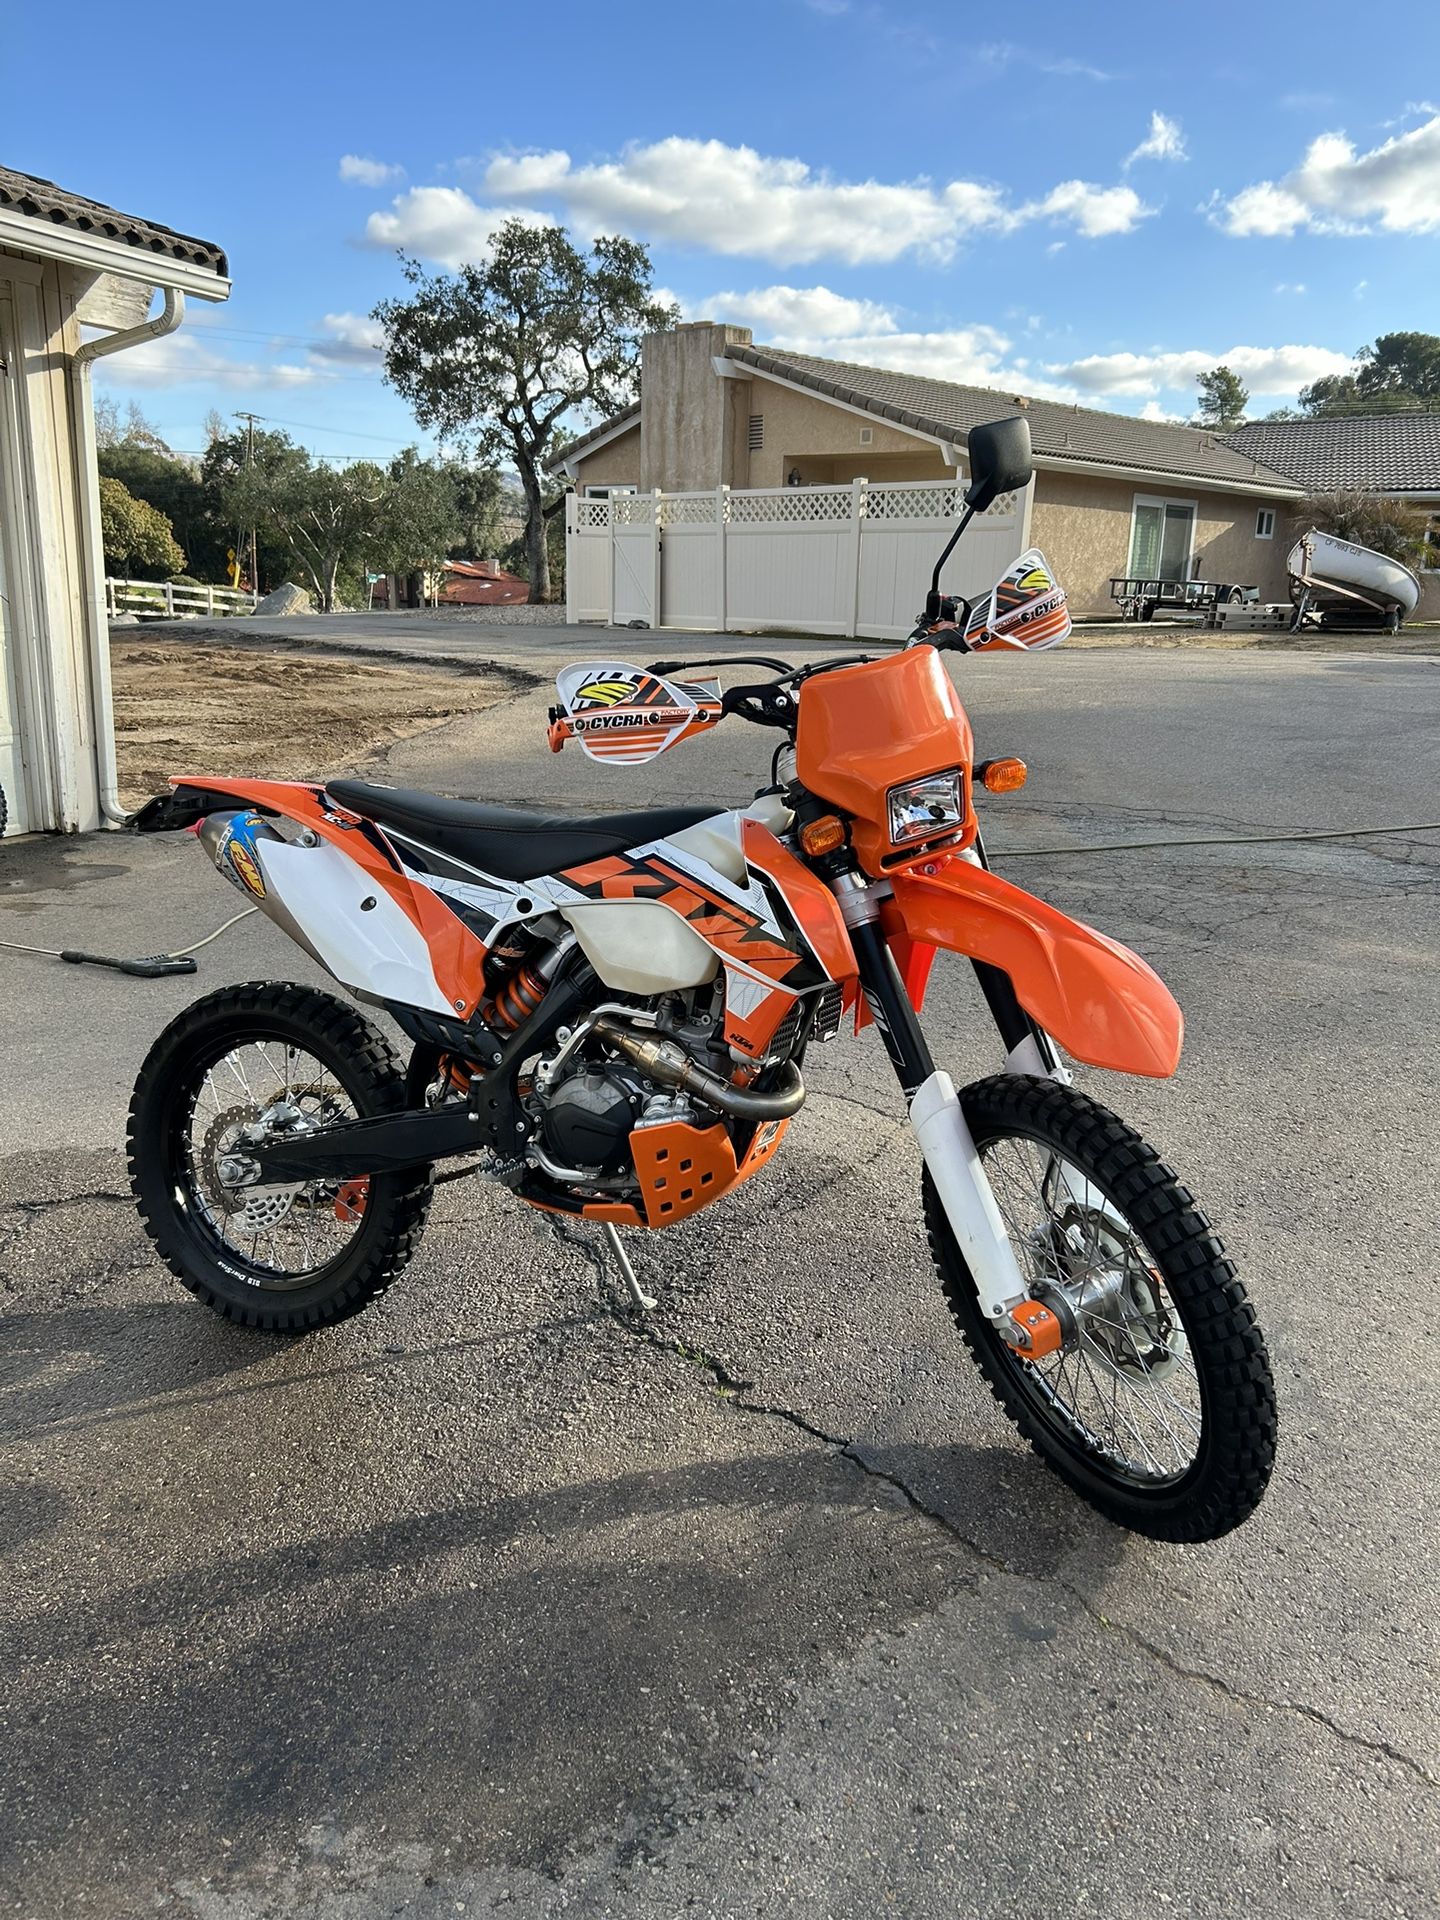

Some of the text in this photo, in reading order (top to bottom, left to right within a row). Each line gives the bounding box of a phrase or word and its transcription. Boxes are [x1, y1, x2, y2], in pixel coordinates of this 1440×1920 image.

[1034, 593, 1067, 618] CYC
[590, 714, 643, 730] CYCRA
[333, 810, 361, 824] 500
[730, 1033, 754, 1050] KTM
